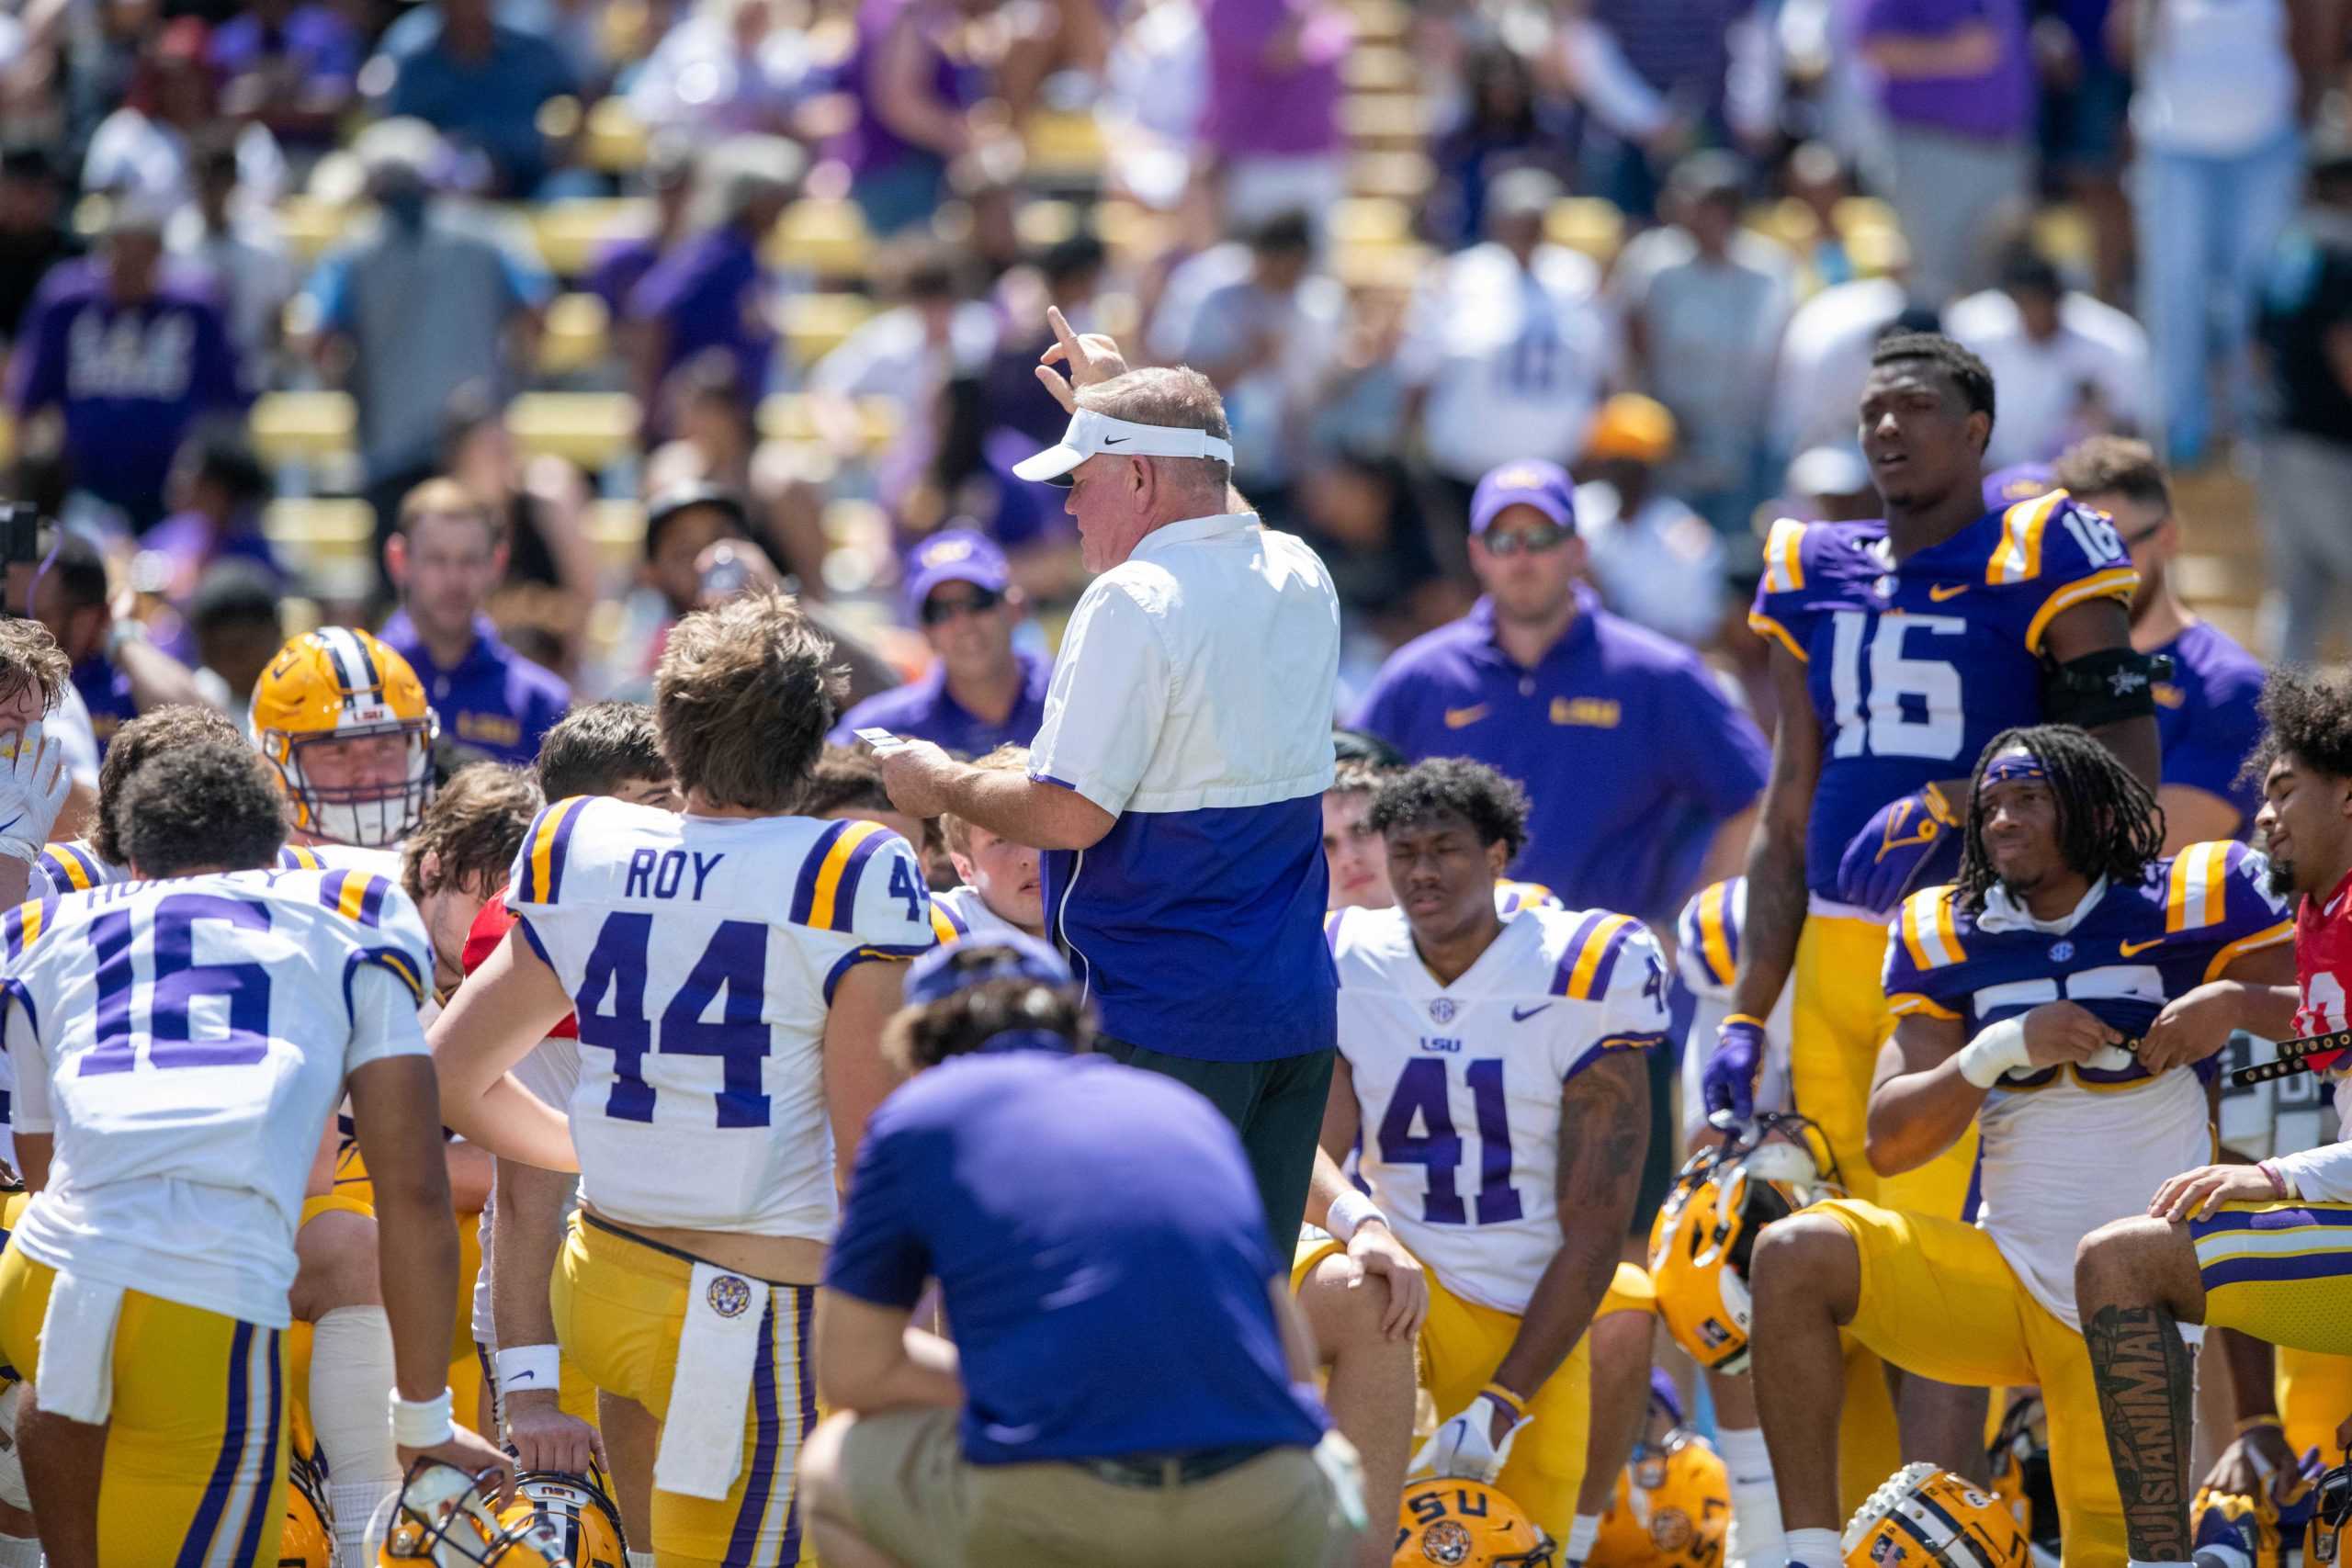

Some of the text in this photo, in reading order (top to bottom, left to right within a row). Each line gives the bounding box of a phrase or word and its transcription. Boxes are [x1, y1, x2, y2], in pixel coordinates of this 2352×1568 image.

[2062, 507, 2122, 569] 16
[1831, 611, 1966, 761] 16
[625, 849, 724, 901] ROY
[78, 894, 272, 1077] 16
[574, 911, 771, 1128] 44
[1420, 1037, 1462, 1053] LSU
[1377, 1057, 1523, 1225] 41
